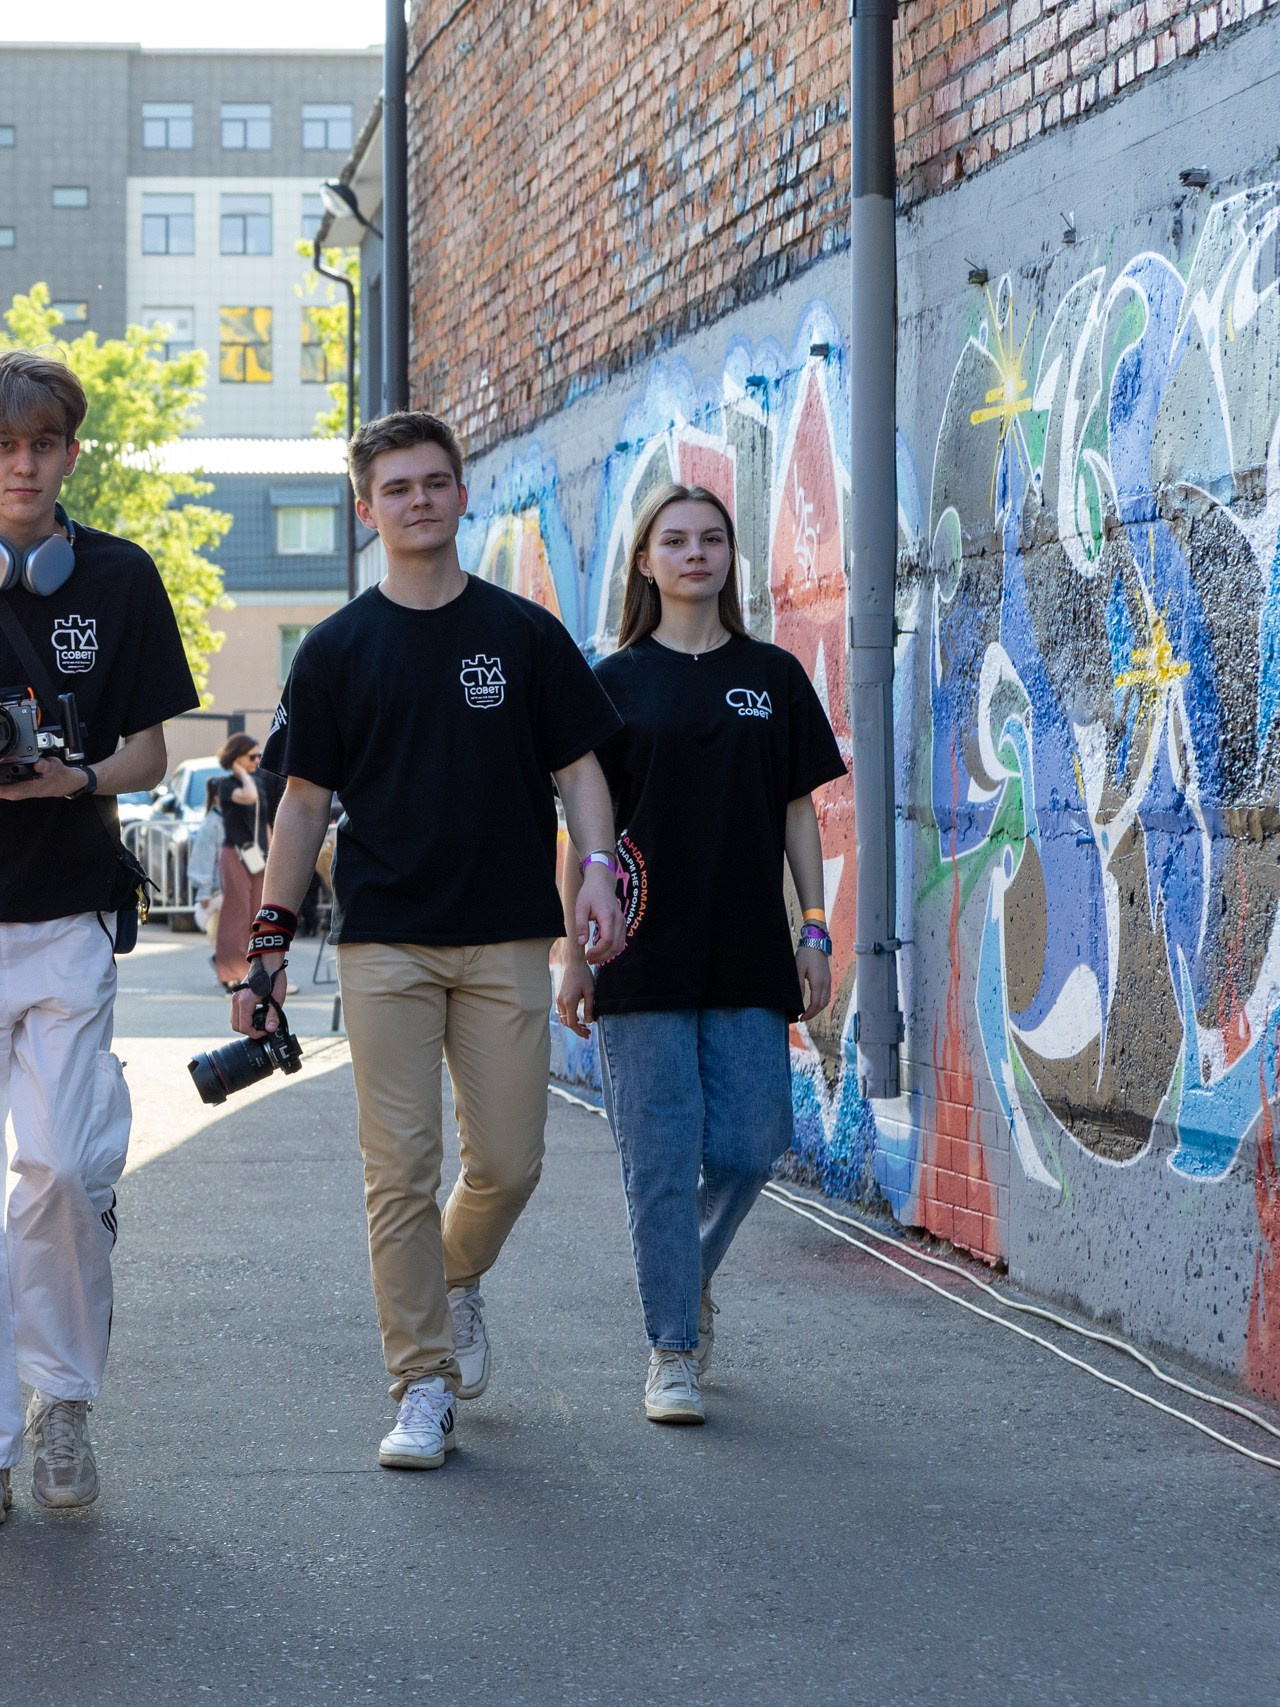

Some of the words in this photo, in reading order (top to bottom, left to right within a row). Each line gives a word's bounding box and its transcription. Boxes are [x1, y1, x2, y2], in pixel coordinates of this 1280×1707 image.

[630, 872, 639, 887] НЕ
[625, 888, 639, 927] ФОНАР
[627, 869, 648, 937] КОМАНДА
[255, 935, 284, 948] EOS
